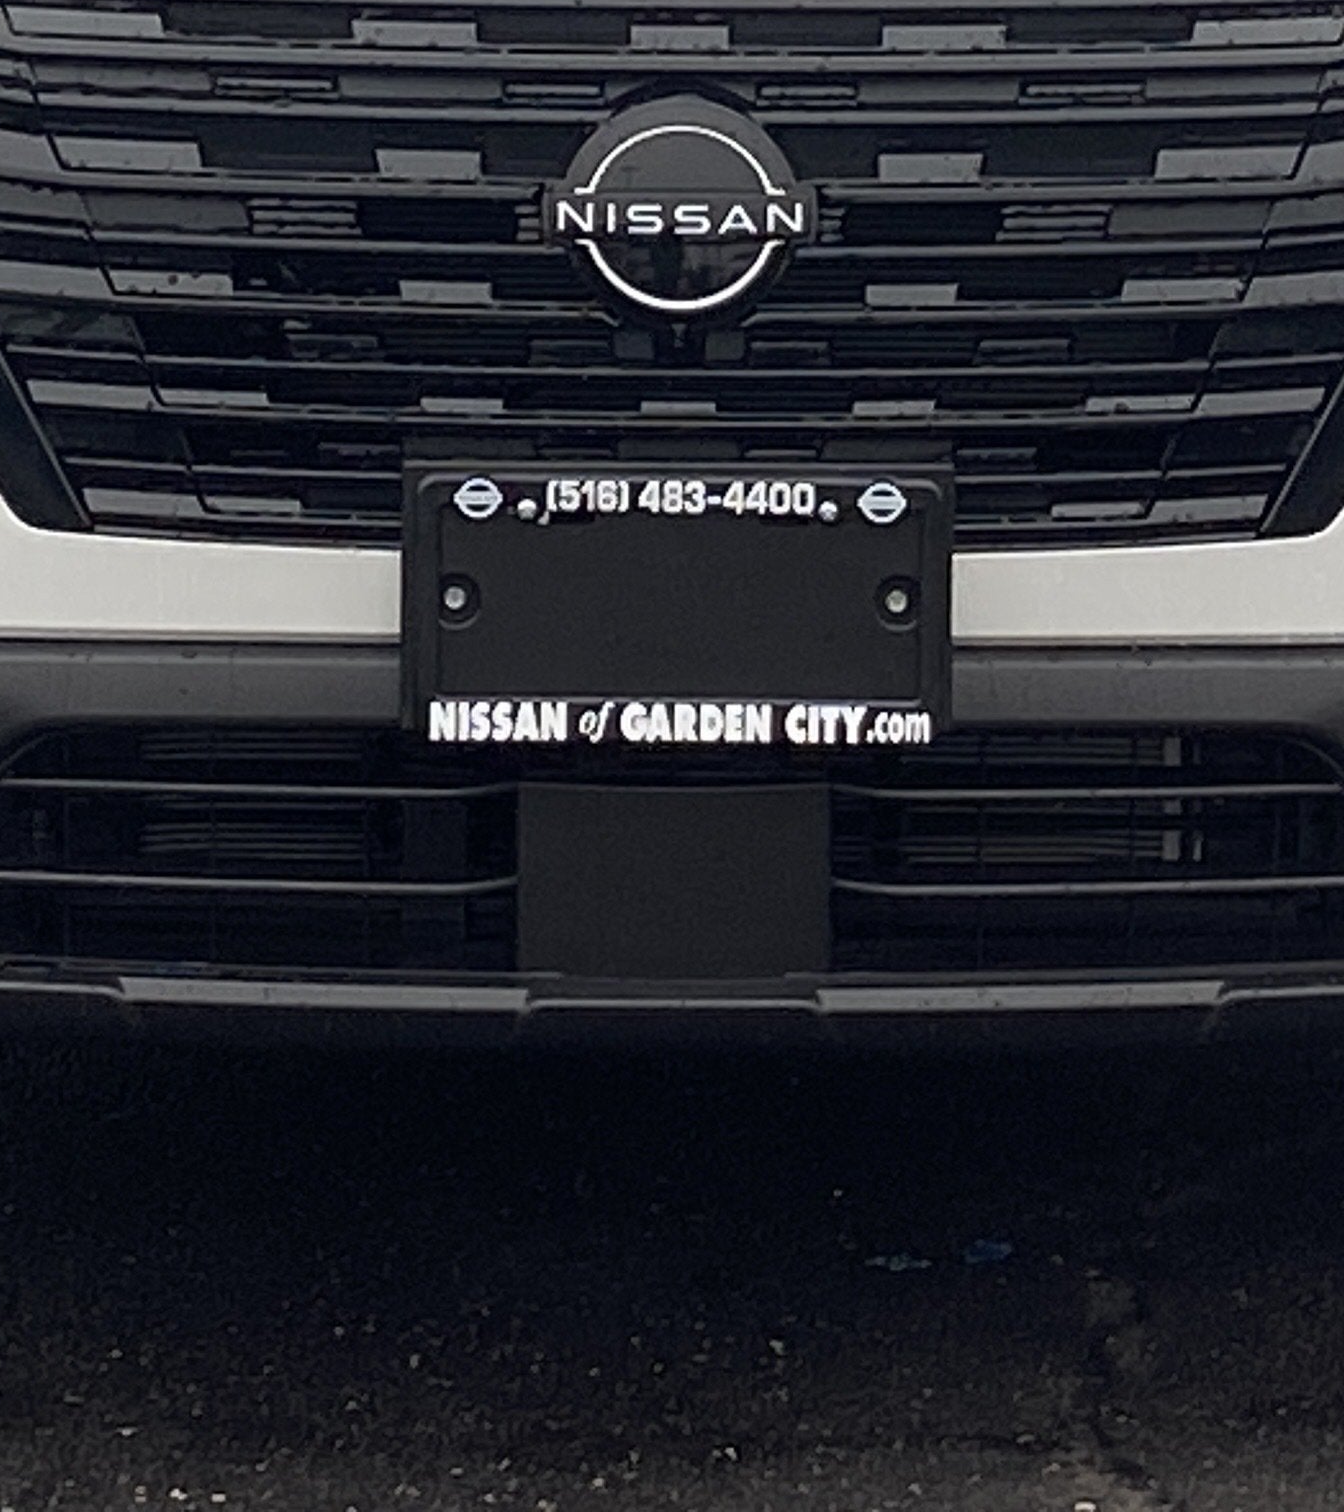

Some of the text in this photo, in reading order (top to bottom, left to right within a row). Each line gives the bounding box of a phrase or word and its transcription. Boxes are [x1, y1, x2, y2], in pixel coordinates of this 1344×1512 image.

[556, 200, 803, 235] NISSAN
[546, 479, 816, 516] (516) 483-4400
[429, 700, 931, 745] NISSAN of GARDEN CITY.com
